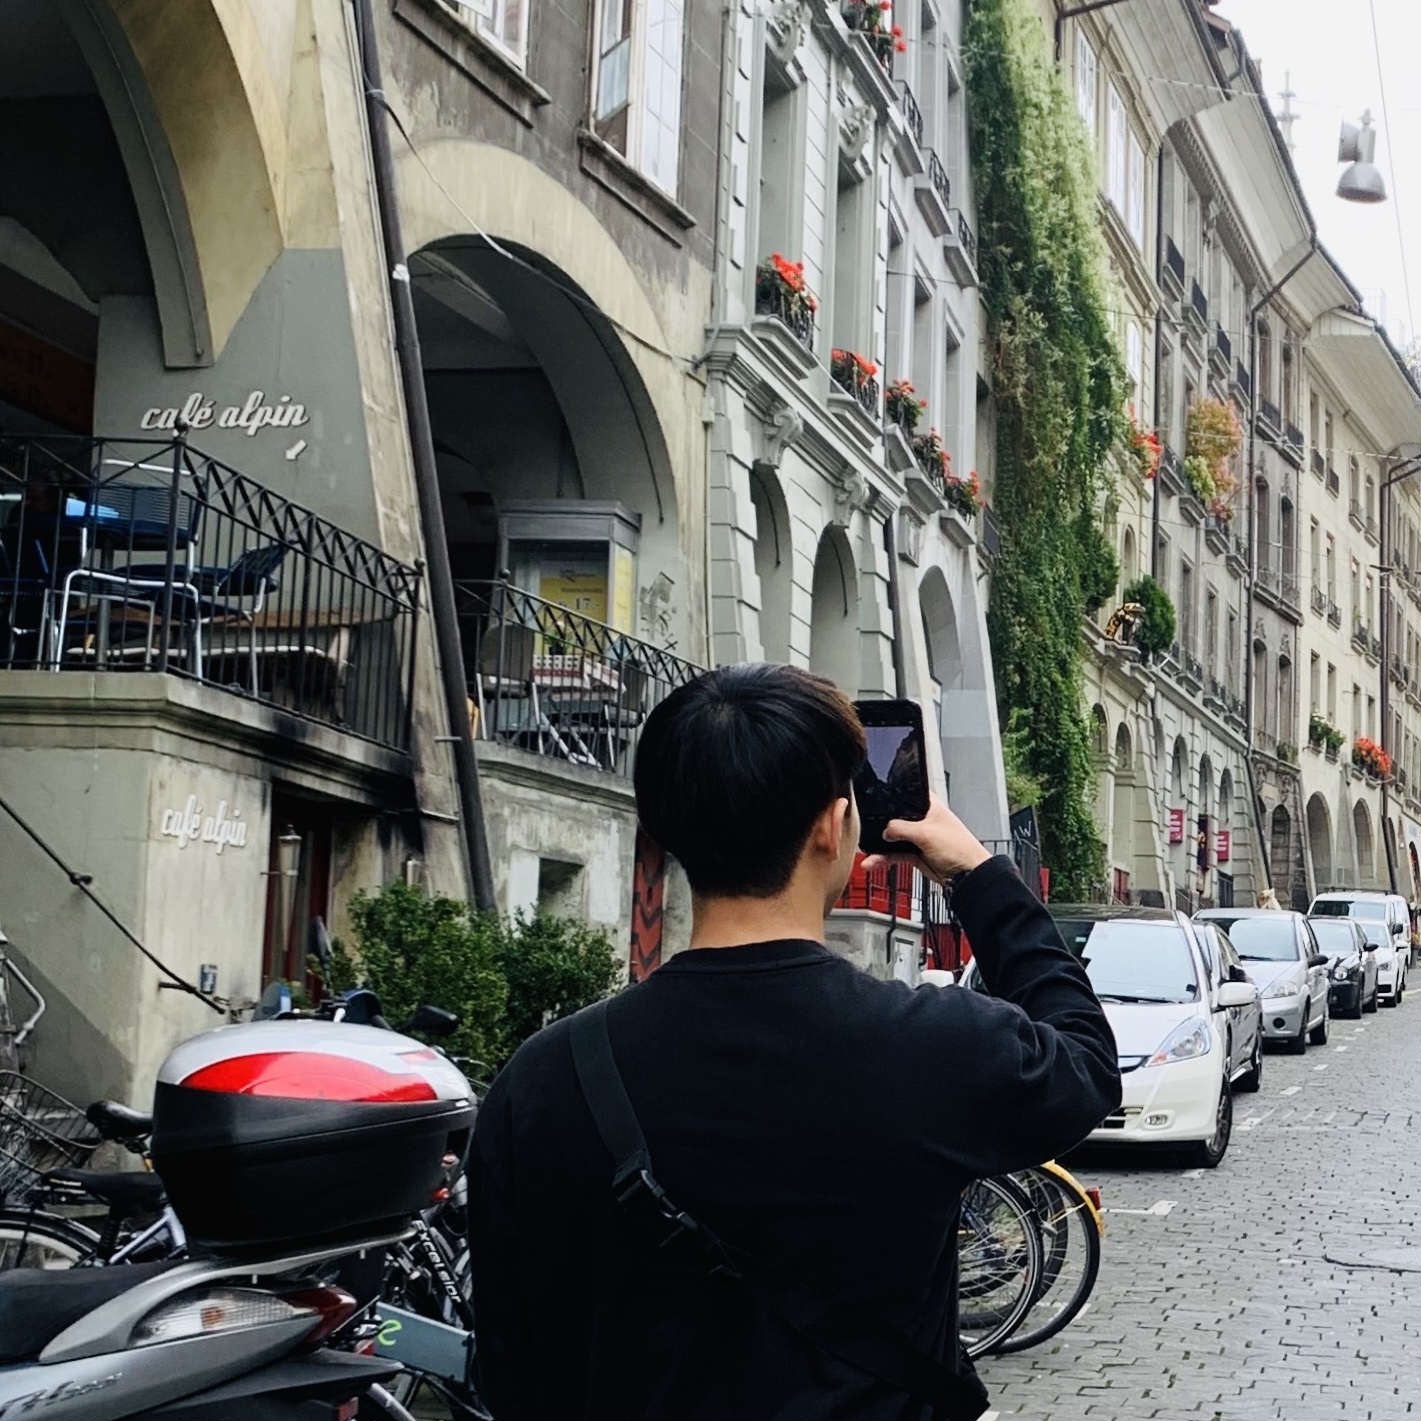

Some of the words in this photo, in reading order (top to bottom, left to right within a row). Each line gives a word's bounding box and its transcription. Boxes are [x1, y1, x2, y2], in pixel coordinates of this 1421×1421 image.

[140, 392, 216, 437] café
[218, 390, 310, 437] alpin
[161, 794, 202, 850] café
[202, 800, 247, 854] alpin
[411, 1219, 462, 1303] Excelsior
